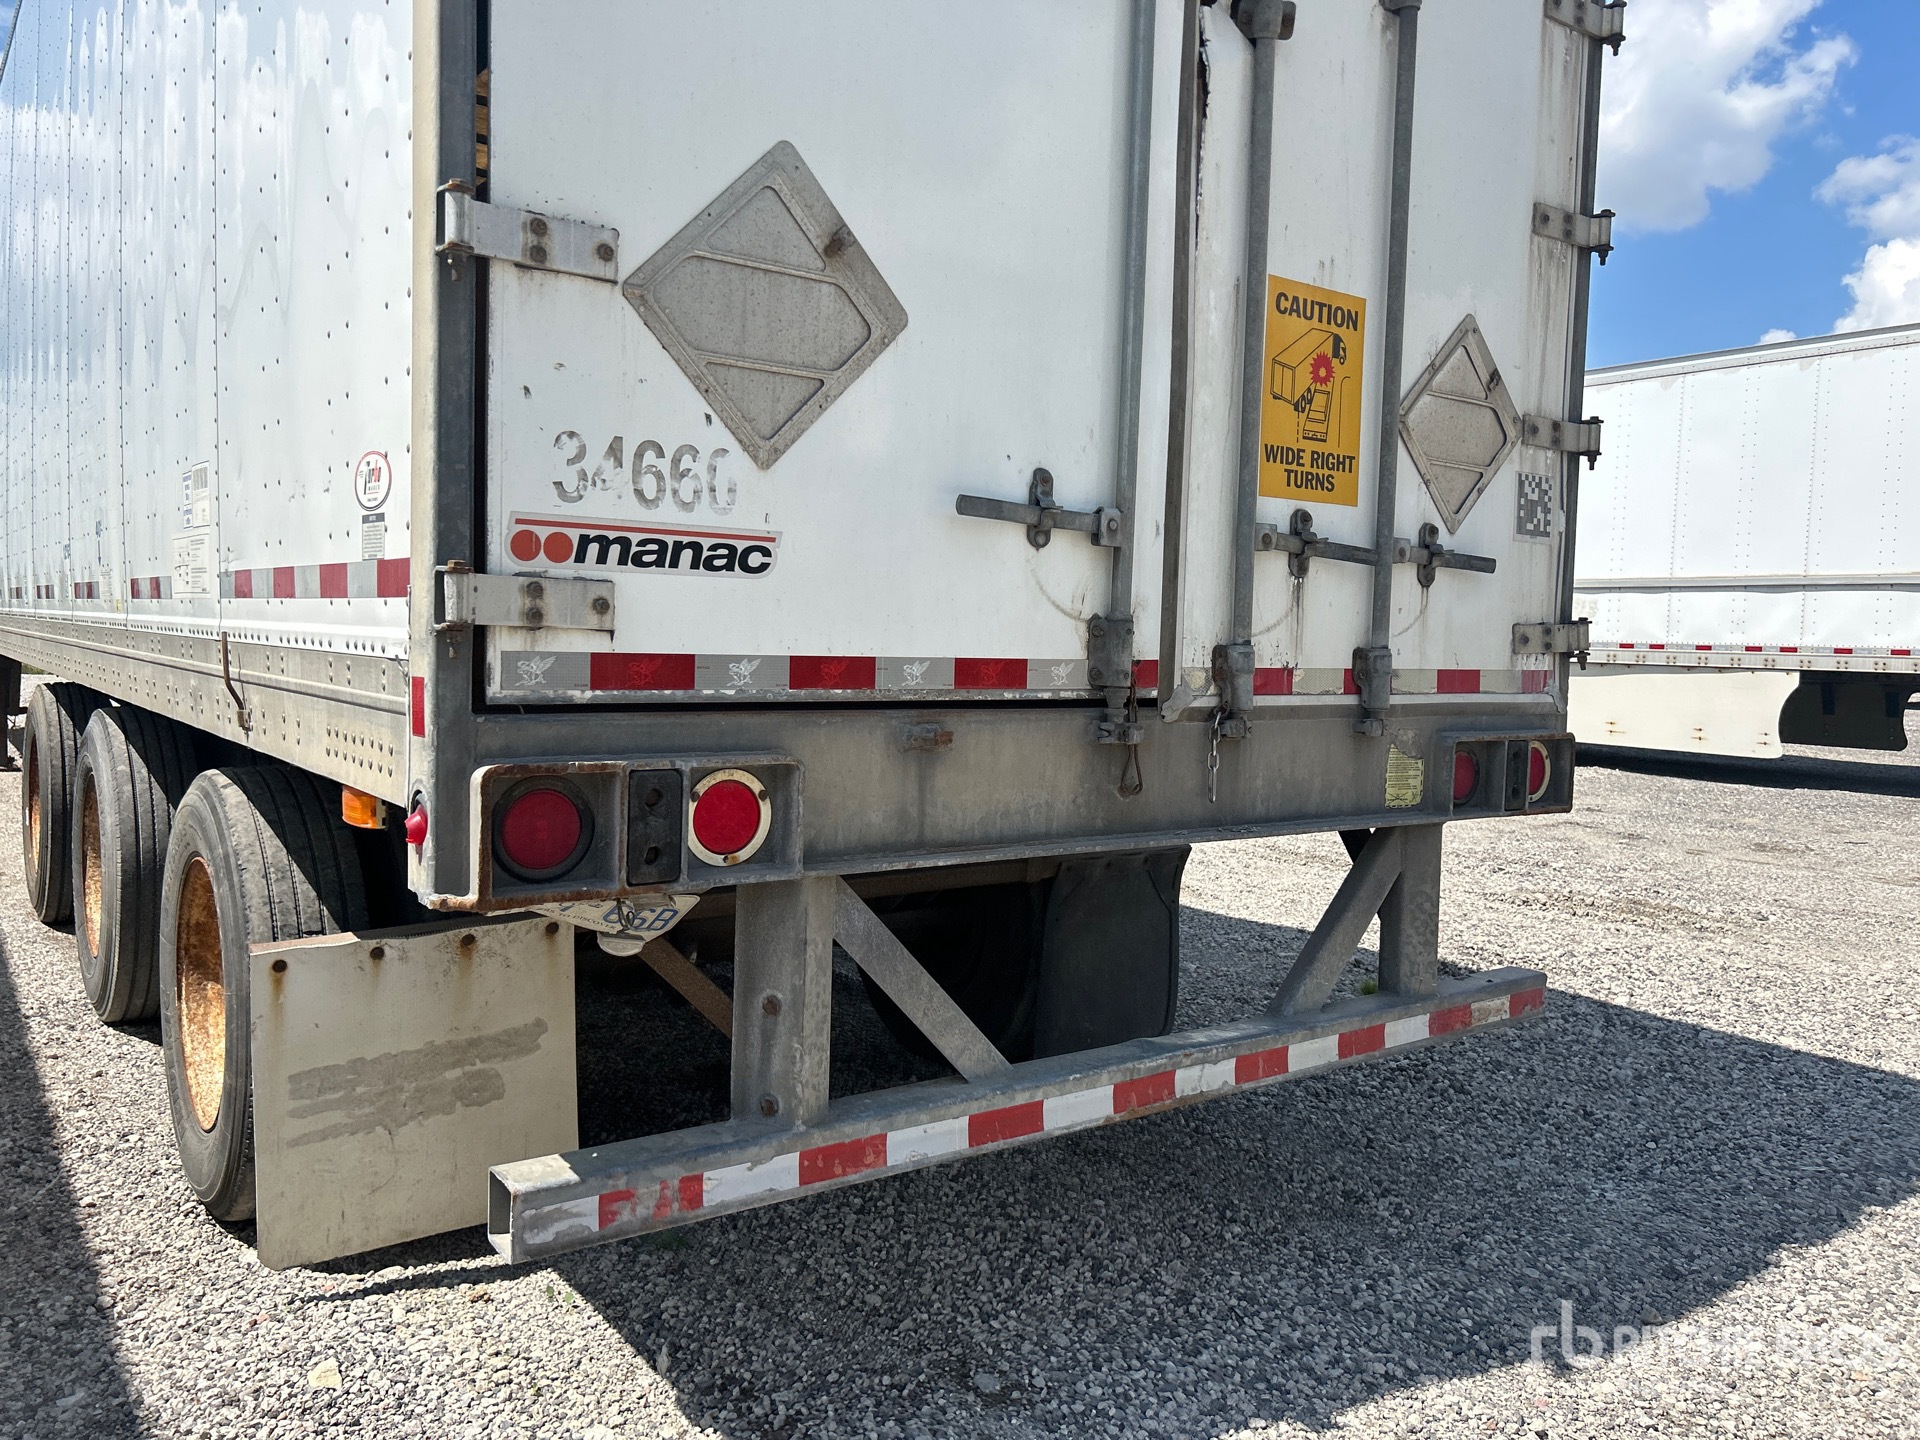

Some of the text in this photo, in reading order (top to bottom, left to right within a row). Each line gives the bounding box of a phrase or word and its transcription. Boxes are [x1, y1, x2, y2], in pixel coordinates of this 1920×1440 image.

[1275, 291, 1359, 332] CAUTION
[1264, 443, 1356, 474] WIDE RIGHT
[1283, 468, 1336, 493] TURNS
[573, 533, 774, 575] manac
[573, 915, 617, 931] DISCOVER
